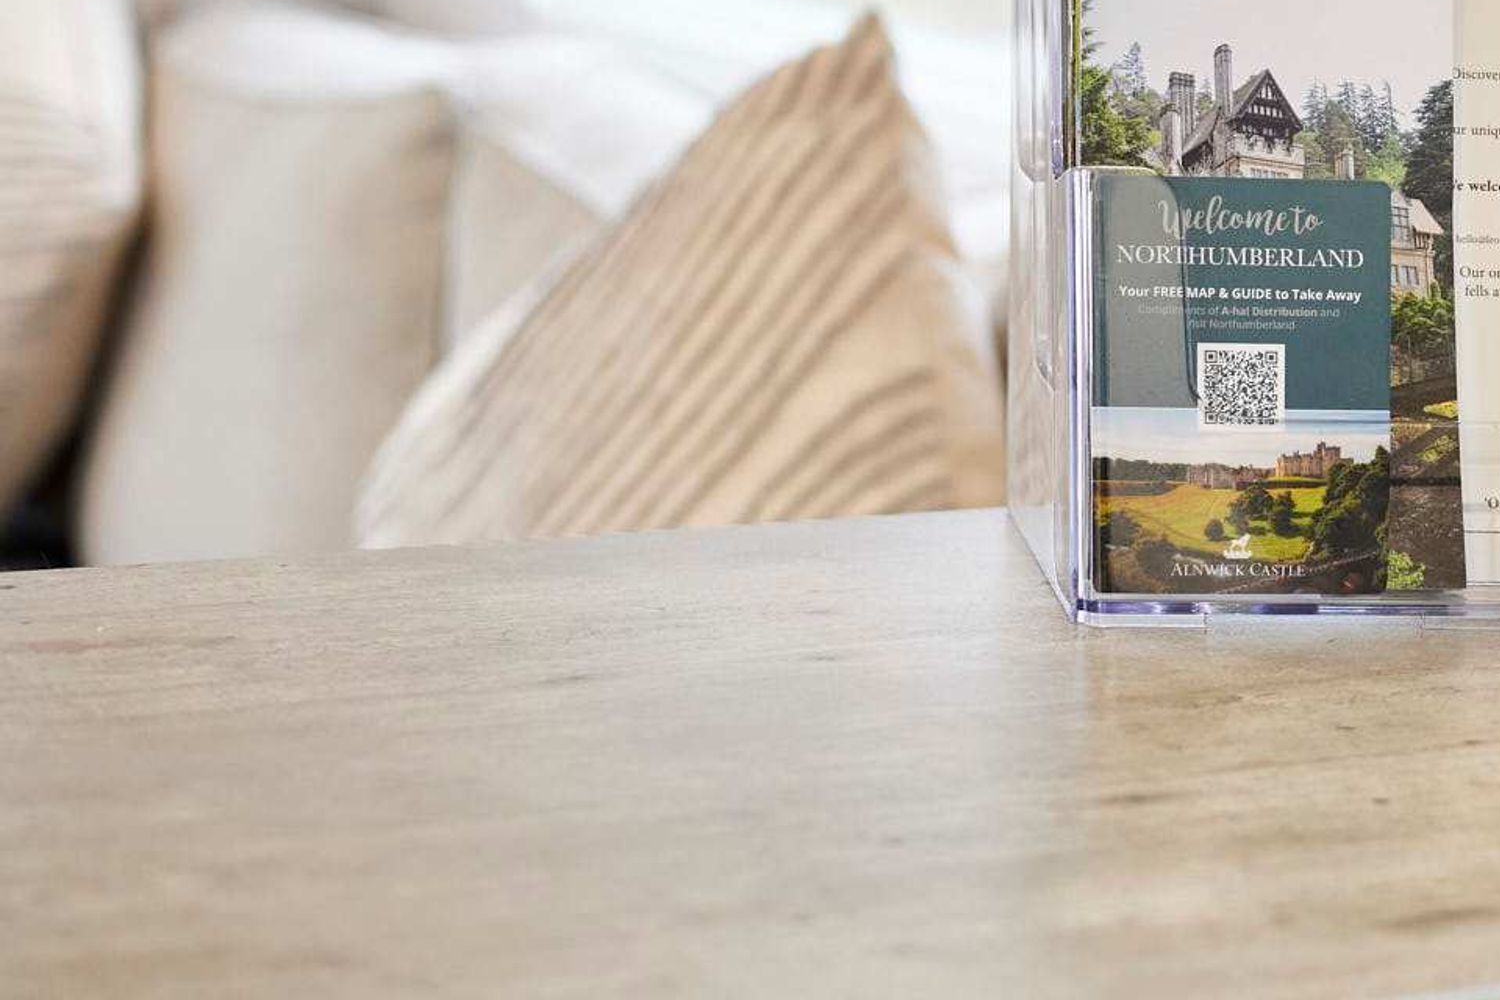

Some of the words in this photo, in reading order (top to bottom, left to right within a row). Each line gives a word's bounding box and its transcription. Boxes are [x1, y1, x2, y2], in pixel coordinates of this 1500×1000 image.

[1158, 195, 1290, 240] Welcome
[1288, 205, 1324, 235] to
[1116, 244, 1364, 269] NORTHUMBERLAND
[1459, 265, 1485, 278] Our
[1118, 285, 1150, 299] Your
[1153, 286, 1184, 299] FREE
[1186, 287, 1216, 299] MAP
[1218, 287, 1229, 300] &
[1232, 288, 1272, 300] GUIDE
[1275, 288, 1289, 300] to
[1292, 288, 1323, 301] Take
[1325, 289, 1362, 304] Away
[1465, 285, 1489, 297] fells
[1208, 305, 1220, 316] of
[1252, 306, 1318, 318] Distribution
[1319, 308, 1341, 318] and
[1170, 563, 1246, 577] ALNWICK
[1249, 563, 1307, 578] CASTLE
